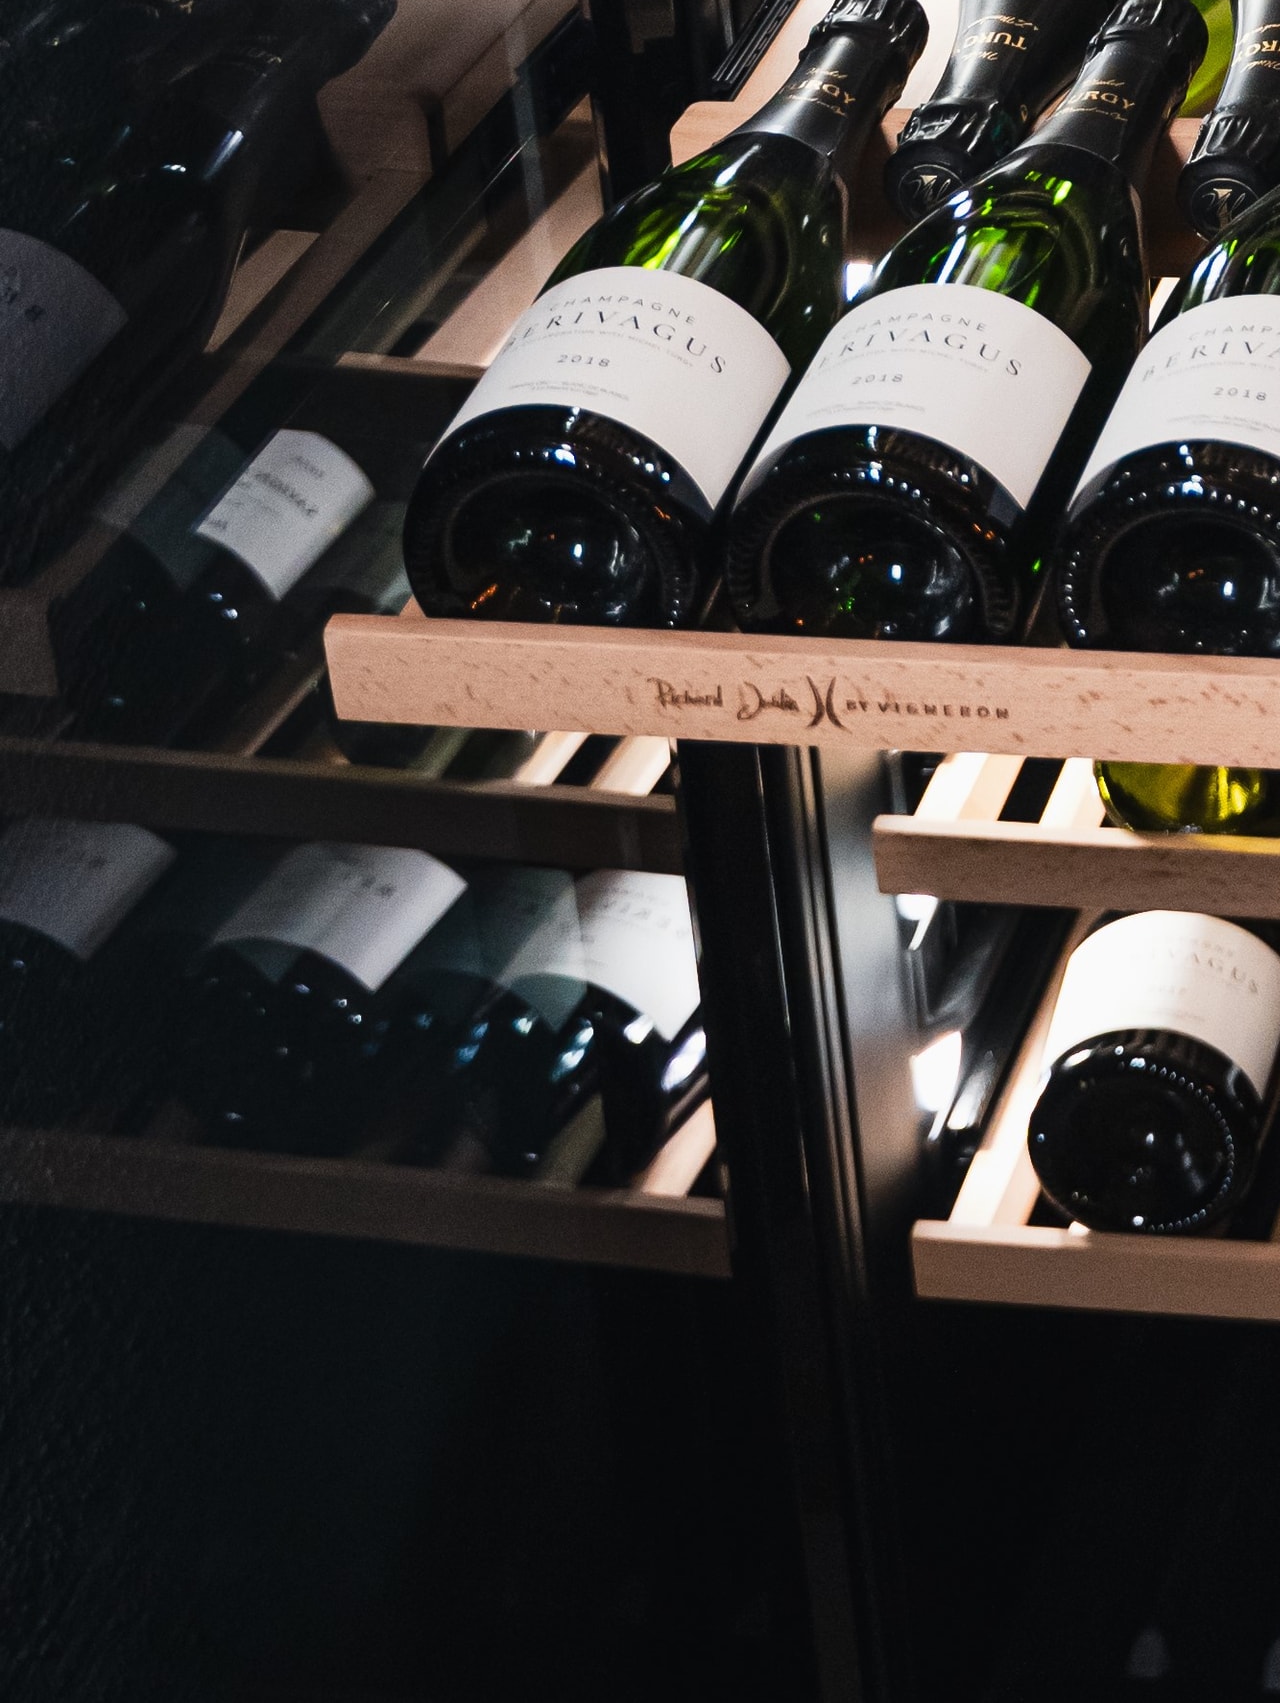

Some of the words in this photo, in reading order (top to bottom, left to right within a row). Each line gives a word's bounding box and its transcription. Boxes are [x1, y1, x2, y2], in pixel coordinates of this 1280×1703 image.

[556, 354, 612, 368] 2018
[852, 373, 904, 385] 2018
[1213, 387, 1268, 401] 2018
[877, 701, 1010, 720] VIGNERON
